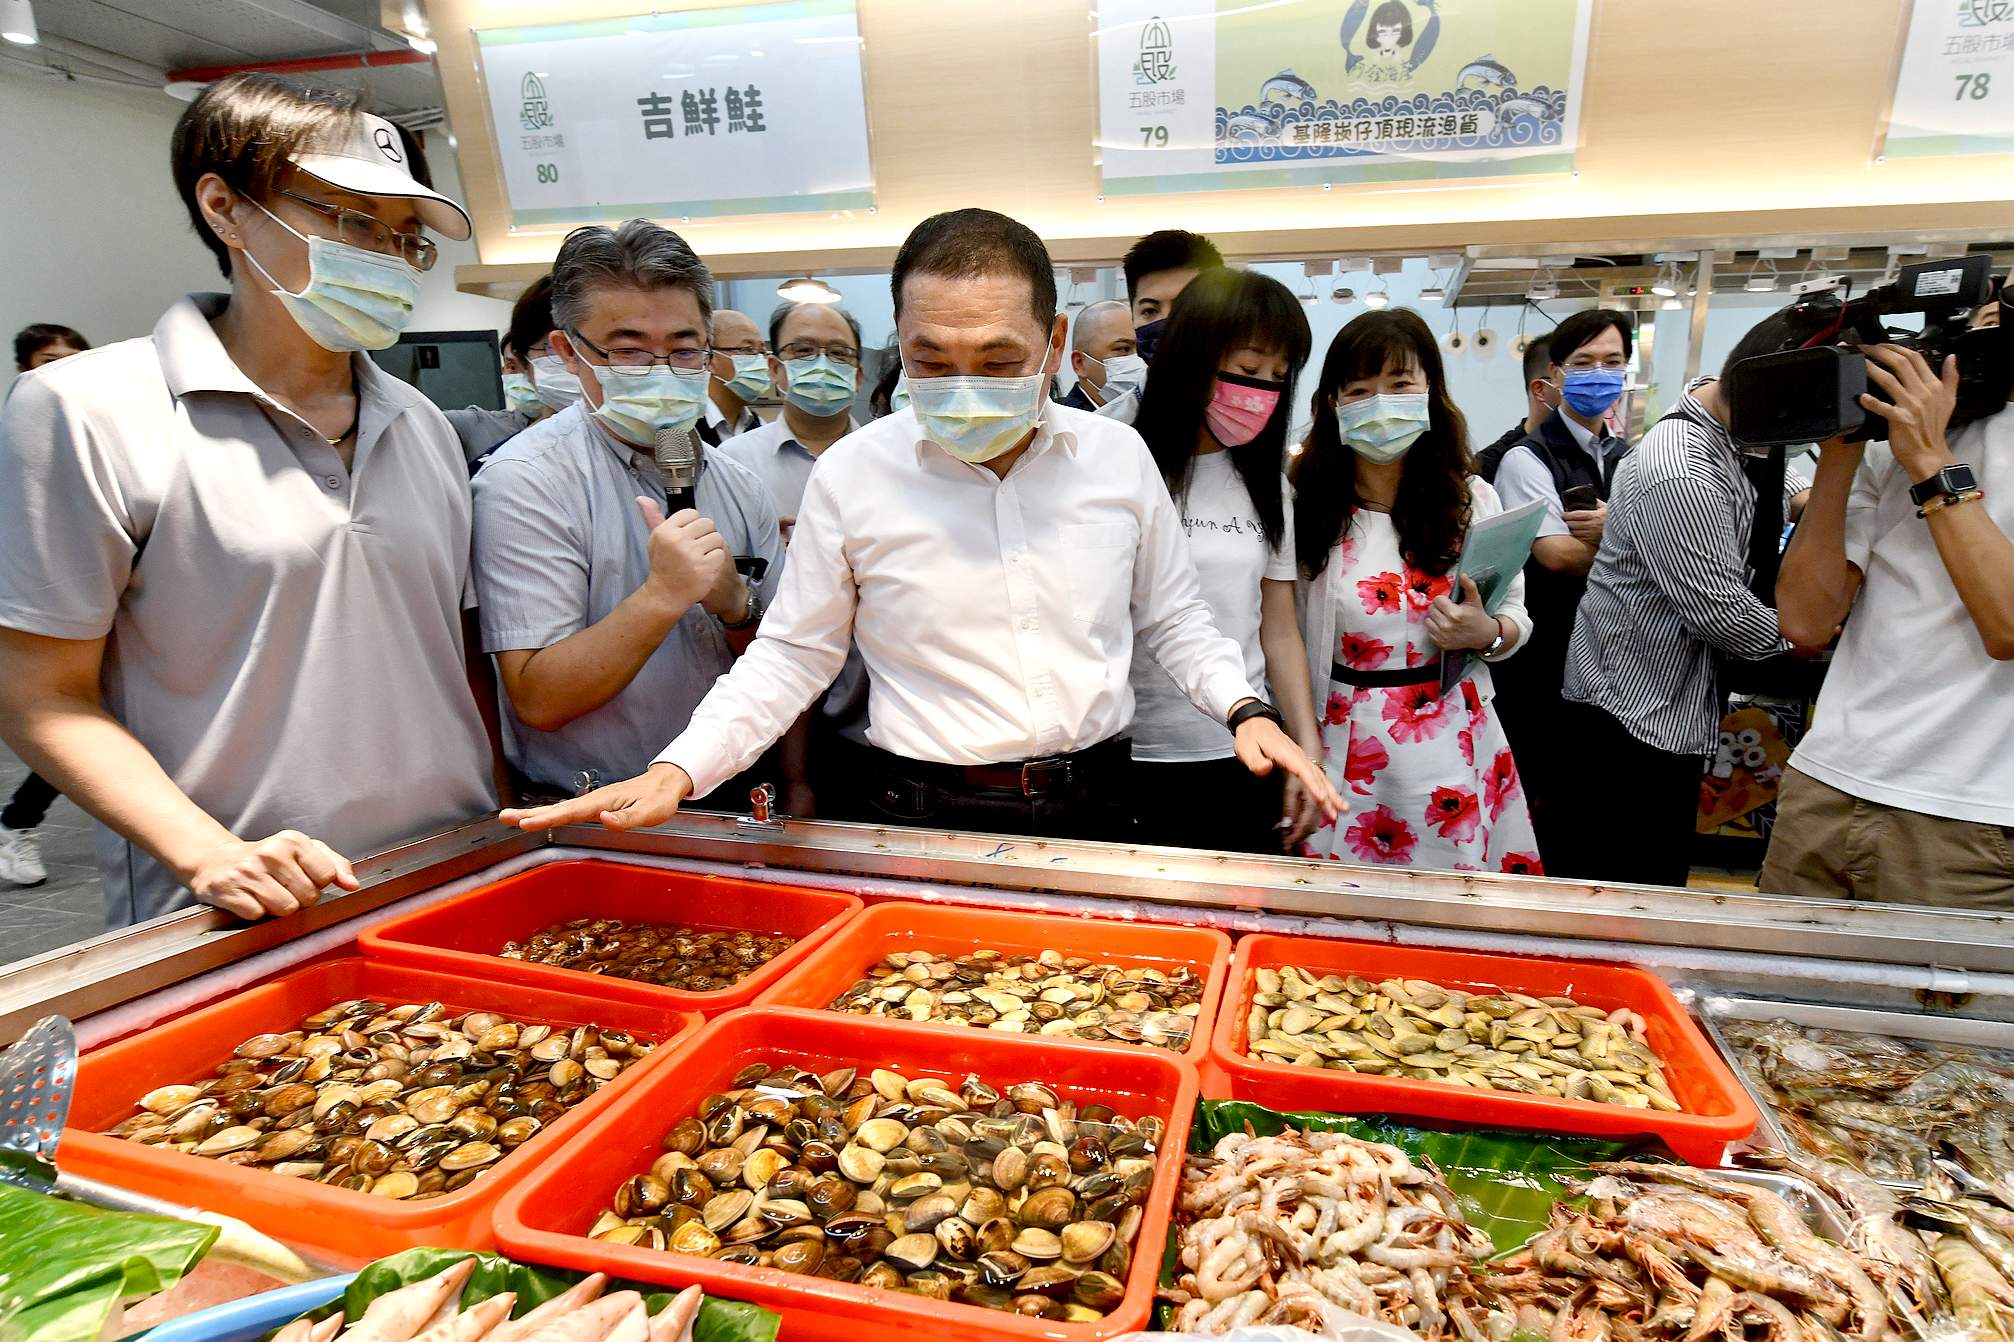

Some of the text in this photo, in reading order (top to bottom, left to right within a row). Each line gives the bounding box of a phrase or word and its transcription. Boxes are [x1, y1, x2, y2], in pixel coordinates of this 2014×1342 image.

[1128, 88, 1185, 108] 五股市場
[1954, 72, 1991, 101] 78
[637, 84, 767, 140] 吉鮮鮭
[1139, 125, 1169, 148] 79
[536, 163, 558, 183] 80
